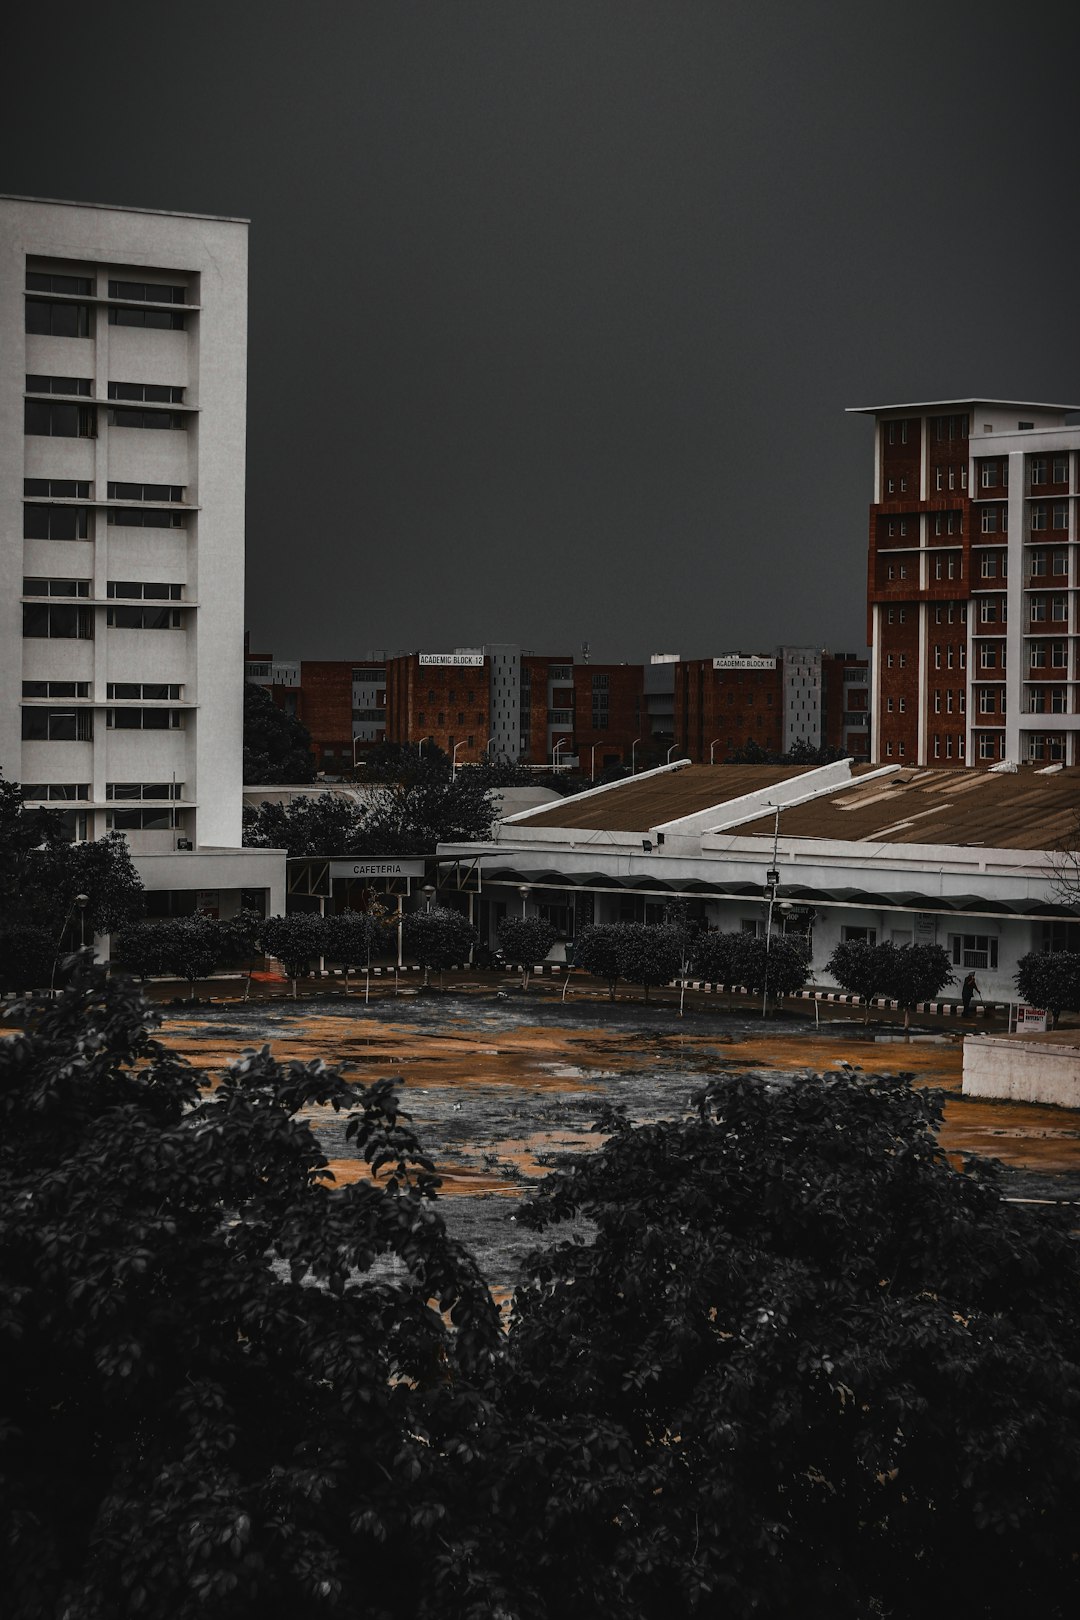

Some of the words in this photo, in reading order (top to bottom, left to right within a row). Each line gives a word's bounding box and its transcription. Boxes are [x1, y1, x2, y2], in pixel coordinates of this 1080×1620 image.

[420, 656, 452, 664] ACADEMIC
[453, 656, 473, 665] BLOCK
[475, 656, 483, 665] 12
[353, 865, 401, 874] CAFETERIA
